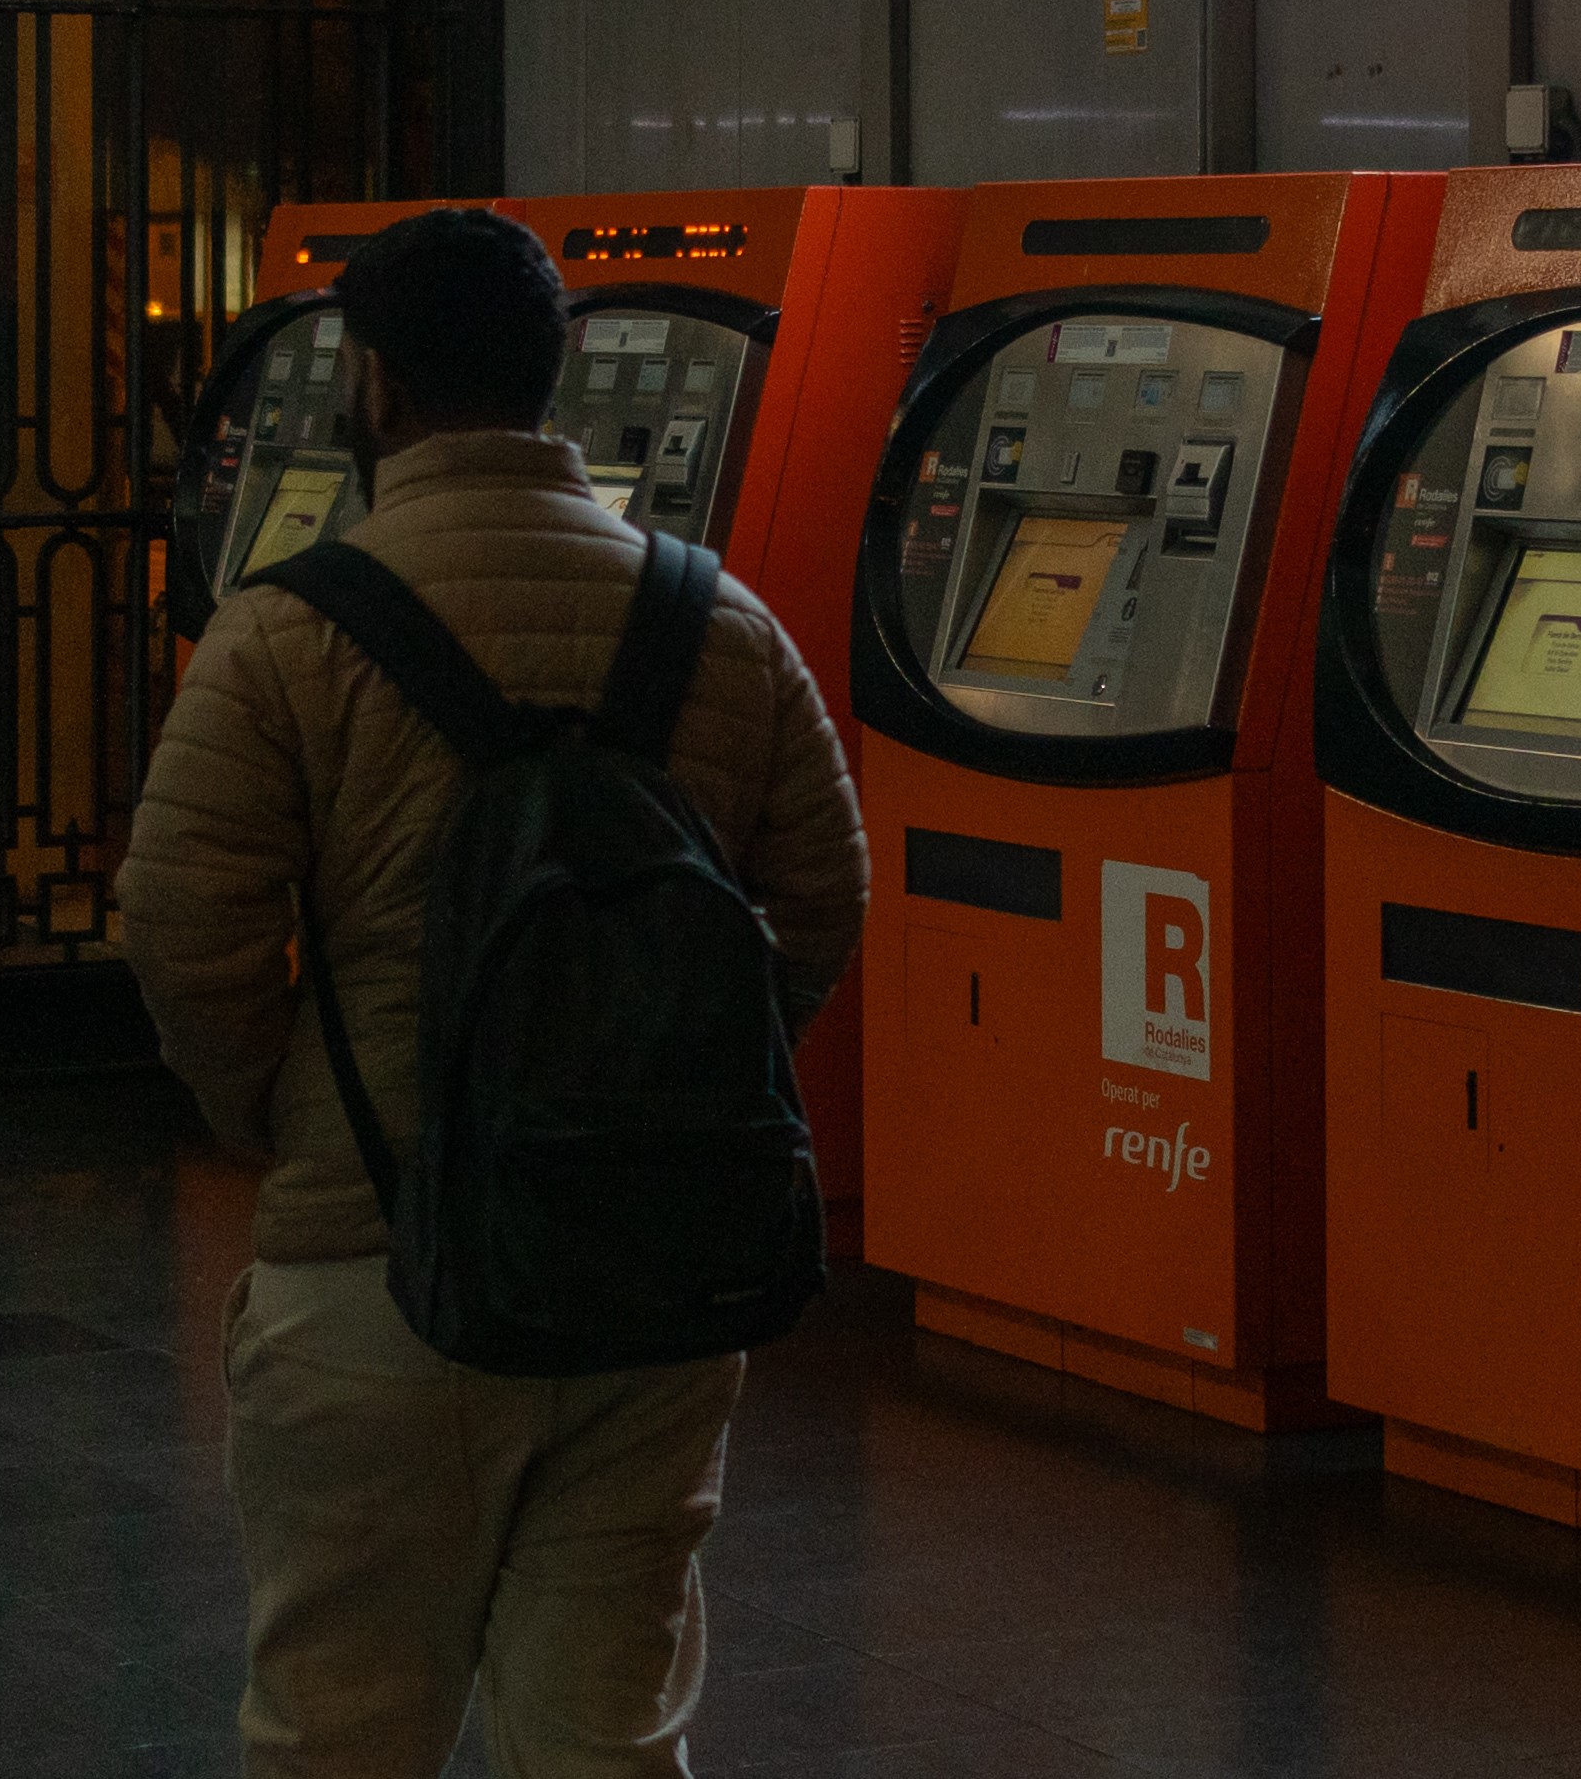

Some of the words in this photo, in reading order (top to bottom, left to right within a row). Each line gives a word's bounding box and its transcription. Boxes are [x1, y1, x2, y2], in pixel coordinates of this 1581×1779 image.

[1419, 488, 1458, 503] Rodalies
[1146, 892, 1206, 1022] R
[1145, 1021, 1205, 1053] Rodalies
[1102, 1077, 1139, 1105] Operat
[1142, 1090, 1161, 1110] per
[1104, 1122, 1211, 1193] renfe
